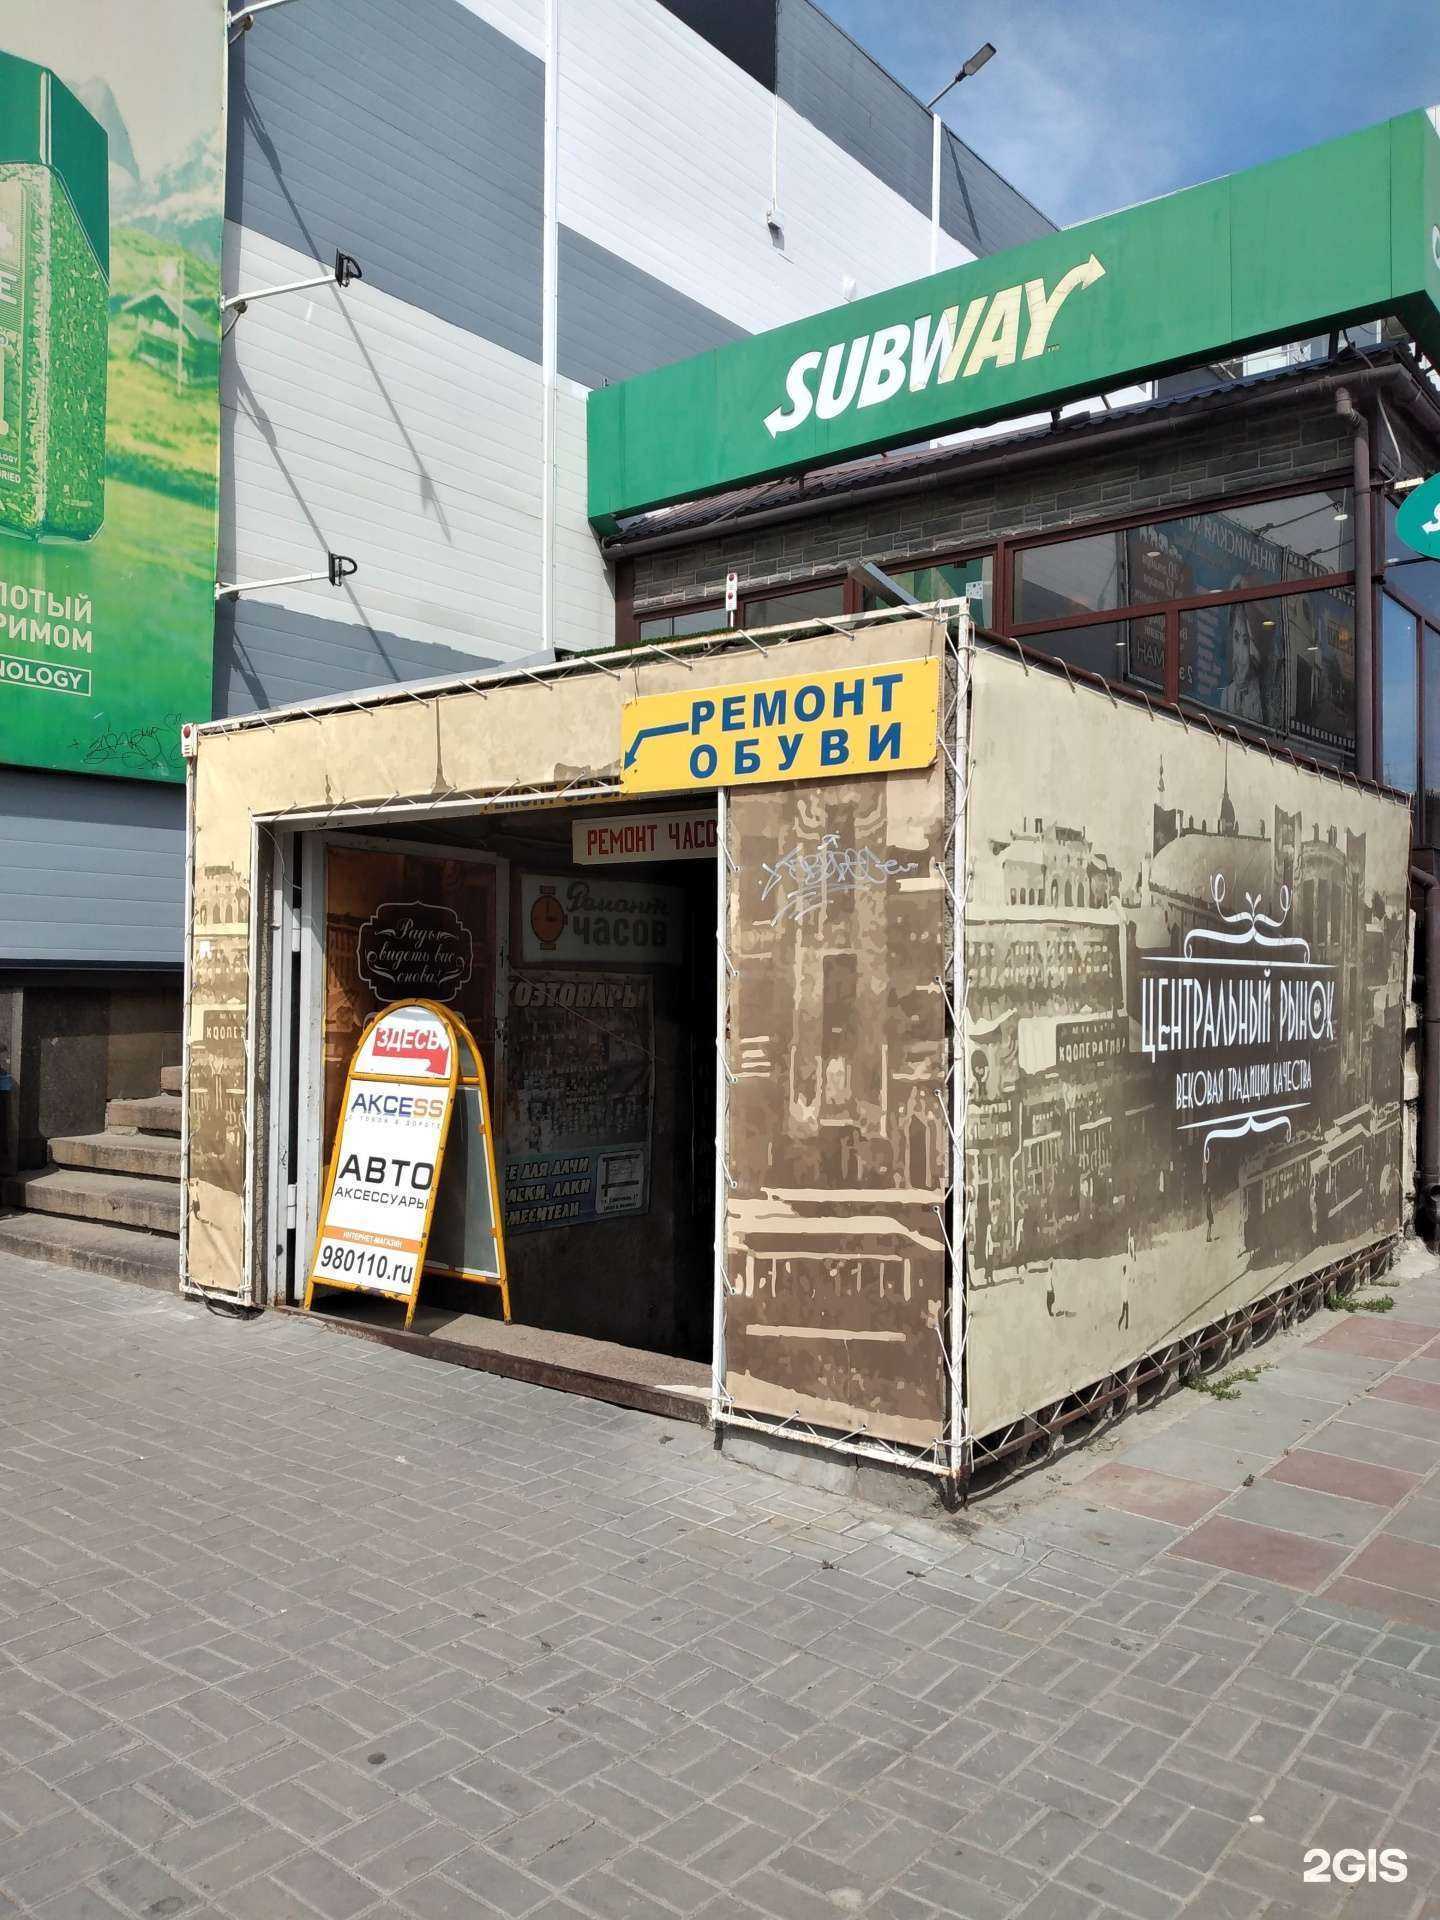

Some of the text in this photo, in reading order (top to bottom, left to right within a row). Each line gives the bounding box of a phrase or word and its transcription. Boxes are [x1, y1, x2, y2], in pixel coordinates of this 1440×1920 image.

[763, 252, 1106, 438] SUBWAY
[690, 673, 904, 735] РЕМОНТ
[689, 722, 902, 779] ОБУВИ
[587, 824, 658, 856] РЕМОНТ
[1141, 967, 1335, 1063] ЦЕНТРАЛЬНЫЙ РЫНОК
[376, 1028, 440, 1052] ЗДЕСЬ
[1176, 1059, 1312, 1110] ВЕКОВАЯ ТРАДИЦИЯ КАЧЕСТВА
[339, 1154, 434, 1190] АВТО
[335, 1186, 430, 1210] АКСЕССУАРЫ
[321, 1245, 413, 1284] 980110.ru
